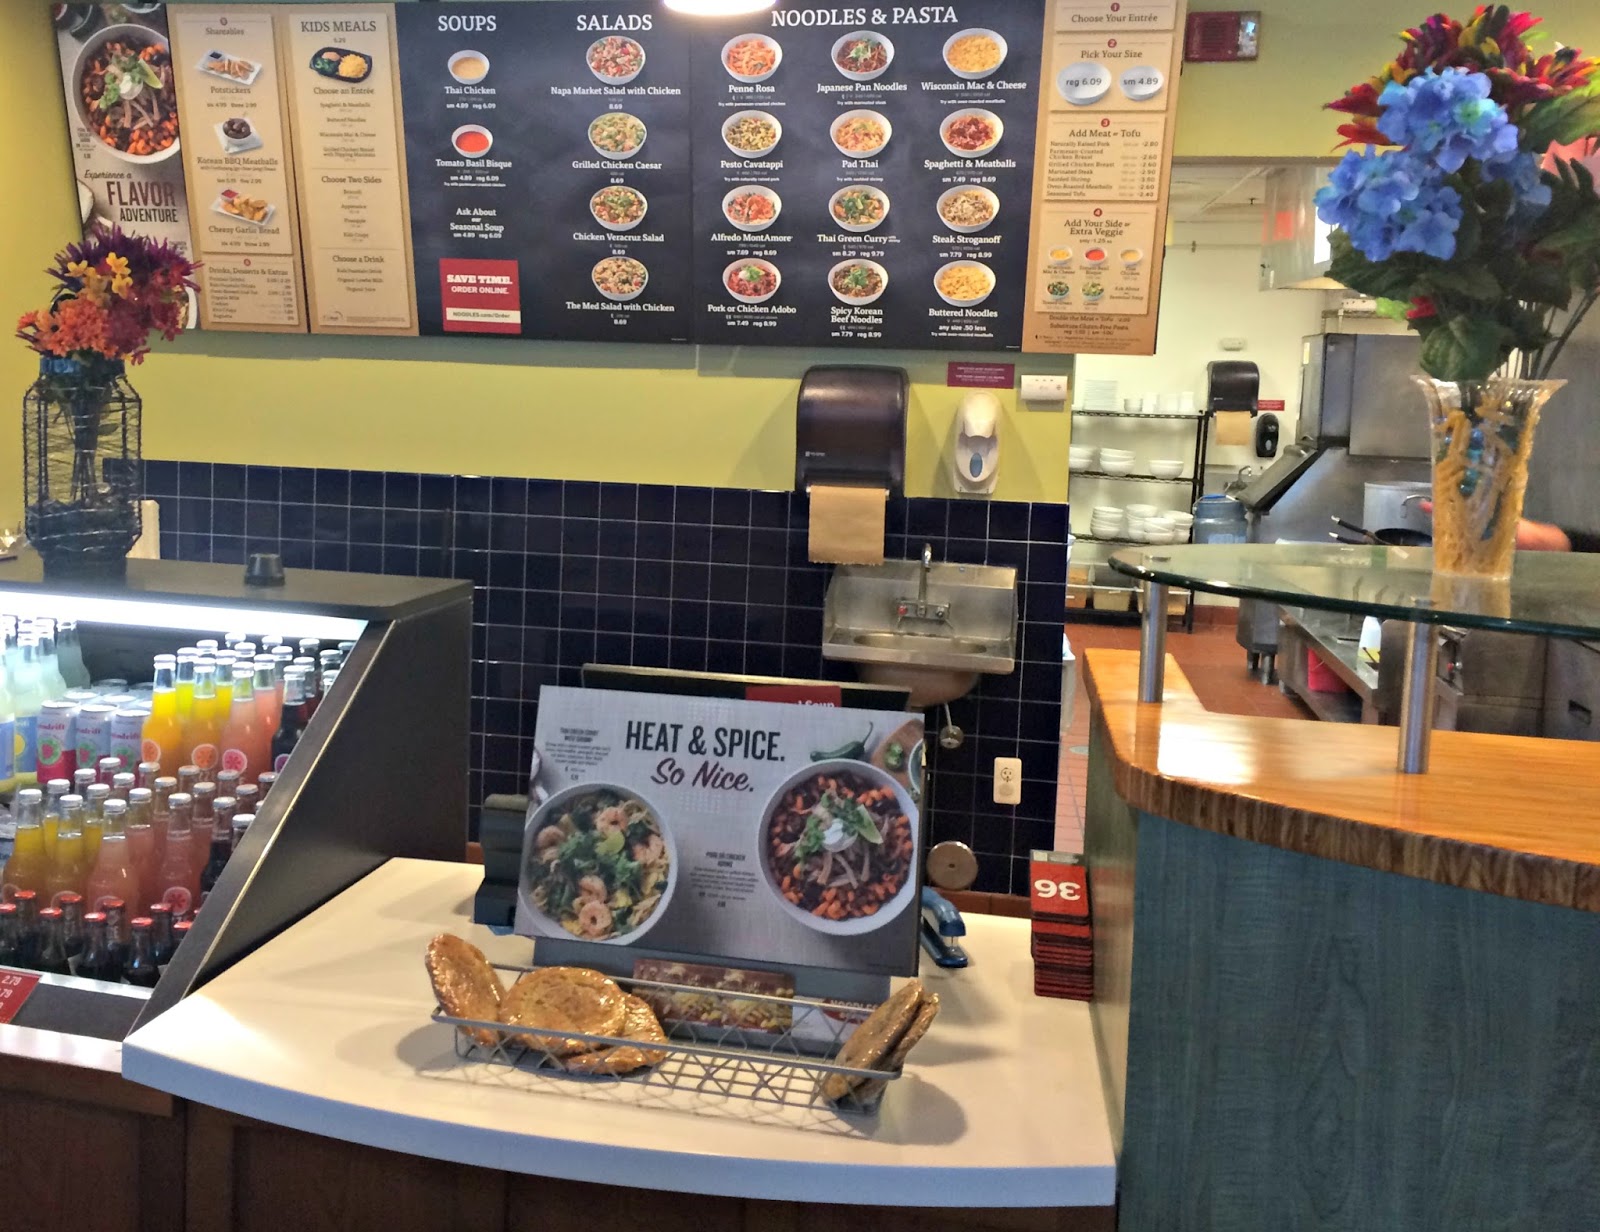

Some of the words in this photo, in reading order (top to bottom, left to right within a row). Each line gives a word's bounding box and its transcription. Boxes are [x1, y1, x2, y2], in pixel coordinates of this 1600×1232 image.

[771, 8, 866, 27] NOODLES
[871, 8, 888, 25] &
[892, 6, 959, 25] PASTA
[1071, 14, 1104, 23] Choose
[1105, 14, 1127, 22] Your
[1128, 13, 1158, 22] Entrée
[301, 21, 331, 32] KIDS
[333, 20, 377, 32] MEALS
[438, 15, 497, 32] SOUPS
[576, 14, 653, 31] SALADS
[205, 27, 245, 35] Shareables
[1080, 50, 1100, 59] Pick
[1101, 50, 1123, 58] Your
[1124, 49, 1143, 58] Size
[921, 82, 965, 91] Wisconsin
[966, 81, 985, 90] Mac
[986, 81, 994, 90] &
[996, 80, 1027, 90] Cheese
[1065, 80, 1080, 88] reg
[1081, 78, 1102, 86] 6.09
[1137, 77, 1159, 85] 4.89
[210, 86, 251, 94] Potstickers
[313, 87, 339, 95] Choose
[444, 86, 463, 94] Thai
[463, 86, 496, 95] Chicken
[550, 86, 572, 96] Napa
[573, 86, 602, 95] Market
[603, 86, 626, 95] Salad
[627, 86, 646, 95] with
[647, 86, 681, 95] Chicken
[728, 85, 754, 93] Penne
[755, 84, 775, 93] Rosa
[816, 83, 853, 94] Japanese
[855, 83, 871, 91] Pan
[873, 82, 907, 91] Noodles
[1068, 129, 1087, 138] Add
[1089, 129, 1112, 138] Meat
[1120, 129, 1141, 138] Tofu
[224, 157, 241, 166] BBQ
[242, 157, 278, 166] Meatballs
[435, 159, 465, 167] Tomato
[465, 159, 485, 168] Basil
[486, 160, 512, 169] Bisque
[572, 160, 600, 169] Grilled
[601, 161, 634, 169] Chicken
[635, 161, 662, 170] Caesar
[720, 160, 742, 169] Pesto
[743, 160, 784, 170] Cavatappi
[841, 160, 858, 168] Pad
[859, 160, 879, 168] Thai
[924, 159, 964, 170] Spaghetti
[965, 160, 973, 168] &
[974, 159, 1016, 168] Meatballs
[84, 169, 125, 181] Experience
[321, 176, 346, 184] Choose
[347, 176, 362, 184] Two
[363, 176, 382, 184] Sides
[106, 181, 176, 207] FLAVOR
[120, 207, 179, 223] ADVENTURE
[456, 208, 471, 216] Ask
[472, 208, 497, 216] About
[450, 222, 483, 231] Seasonal
[484, 223, 505, 232] Soup
[1064, 219, 1082, 227] Add
[1105, 219, 1123, 228] Side
[209, 225, 234, 234] Cheesy
[235, 226, 257, 234] Garlic
[1070, 227, 1093, 235] Extra
[1095, 228, 1124, 237] Veggie
[573, 232, 605, 241] Chicken
[606, 233, 641, 241] Veracruz
[642, 234, 665, 242] Salad
[710, 233, 742, 242] Alfredo
[742, 234, 792, 242] MontAmore
[817, 234, 836, 242] Thai
[837, 234, 862, 242] Green
[863, 234, 889, 244] Curry
[932, 235, 956, 244] Steak
[956, 235, 1001, 245] Stroganoff
[332, 255, 357, 263] Choose
[446, 274, 477, 284] SAVE
[477, 275, 513, 284] TIME.
[451, 285, 478, 293] ORDER
[478, 286, 510, 295] ONLINE.
[566, 301, 581, 310] The
[582, 302, 600, 310] Med
[600, 302, 622, 311] Salad
[623, 303, 642, 311] with
[642, 303, 675, 312] Chicken
[707, 304, 726, 312] Pork
[736, 304, 769, 313] Chicken
[770, 305, 797, 313] Adobo
[830, 306, 853, 316] Spicy
[853, 307, 883, 315] Korean
[928, 308, 964, 317] Buttered
[964, 309, 998, 317] Noodles
[830, 315, 849, 323] Beef
[850, 315, 883, 324] Noodles
[625, 720, 684, 753] HEAT
[688, 725, 707, 755] &
[713, 727, 786, 762] SPICE.
[650, 757, 686, 786] So
[691, 761, 755, 793] Nice.
[1034, 879, 1082, 901] 36
